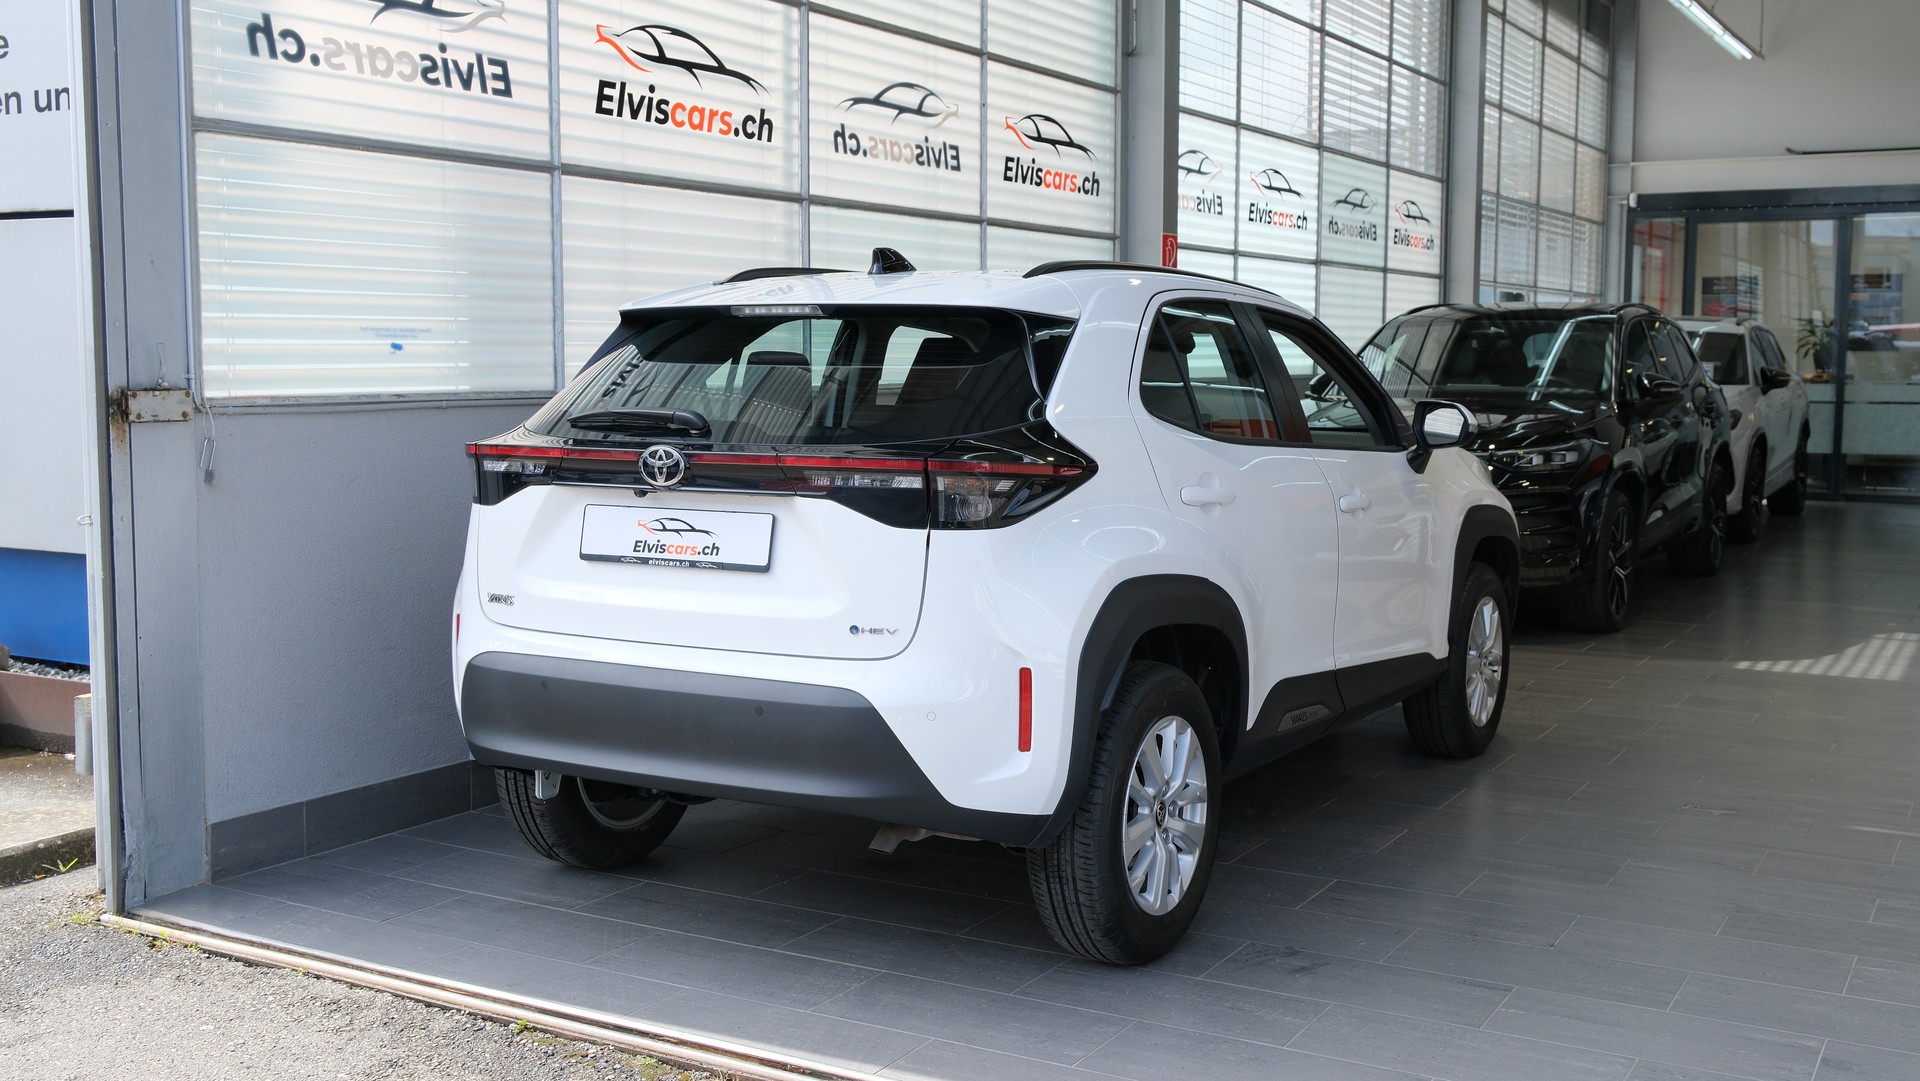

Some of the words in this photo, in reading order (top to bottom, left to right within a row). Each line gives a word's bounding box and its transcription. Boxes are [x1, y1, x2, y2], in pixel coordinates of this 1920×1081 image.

[0, 91, 22, 115] n
[595, 78, 774, 143] Elviscars.ch
[1003, 156, 1100, 197] Elviscars.ch
[1248, 201, 1308, 231] Elviscars.ch
[1393, 228, 1435, 251] Elviscars.ch
[633, 539, 720, 557] Elviscars.ch
[648, 558, 690, 568] elviscars.ch
[860, 627, 899, 636] HEV
